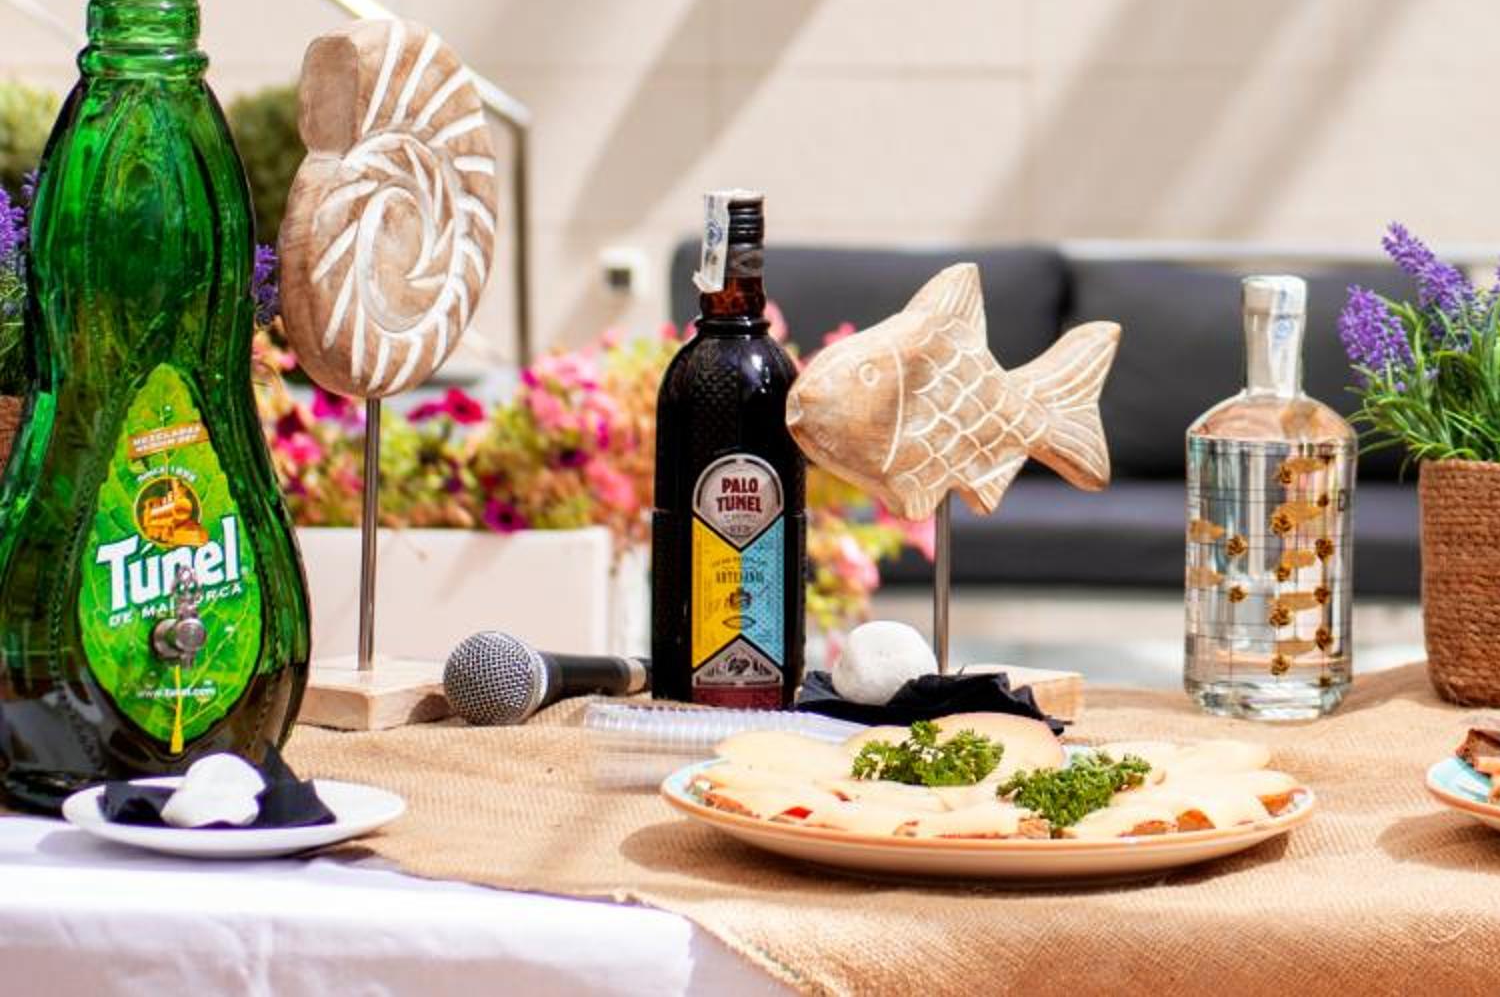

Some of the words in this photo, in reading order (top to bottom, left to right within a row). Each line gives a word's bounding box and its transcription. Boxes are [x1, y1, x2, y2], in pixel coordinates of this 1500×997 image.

[721, 478, 759, 494] PALO
[716, 496, 763, 513] TUNEL
[96, 516, 239, 613] Túnel
[108, 611, 133, 628] DE
